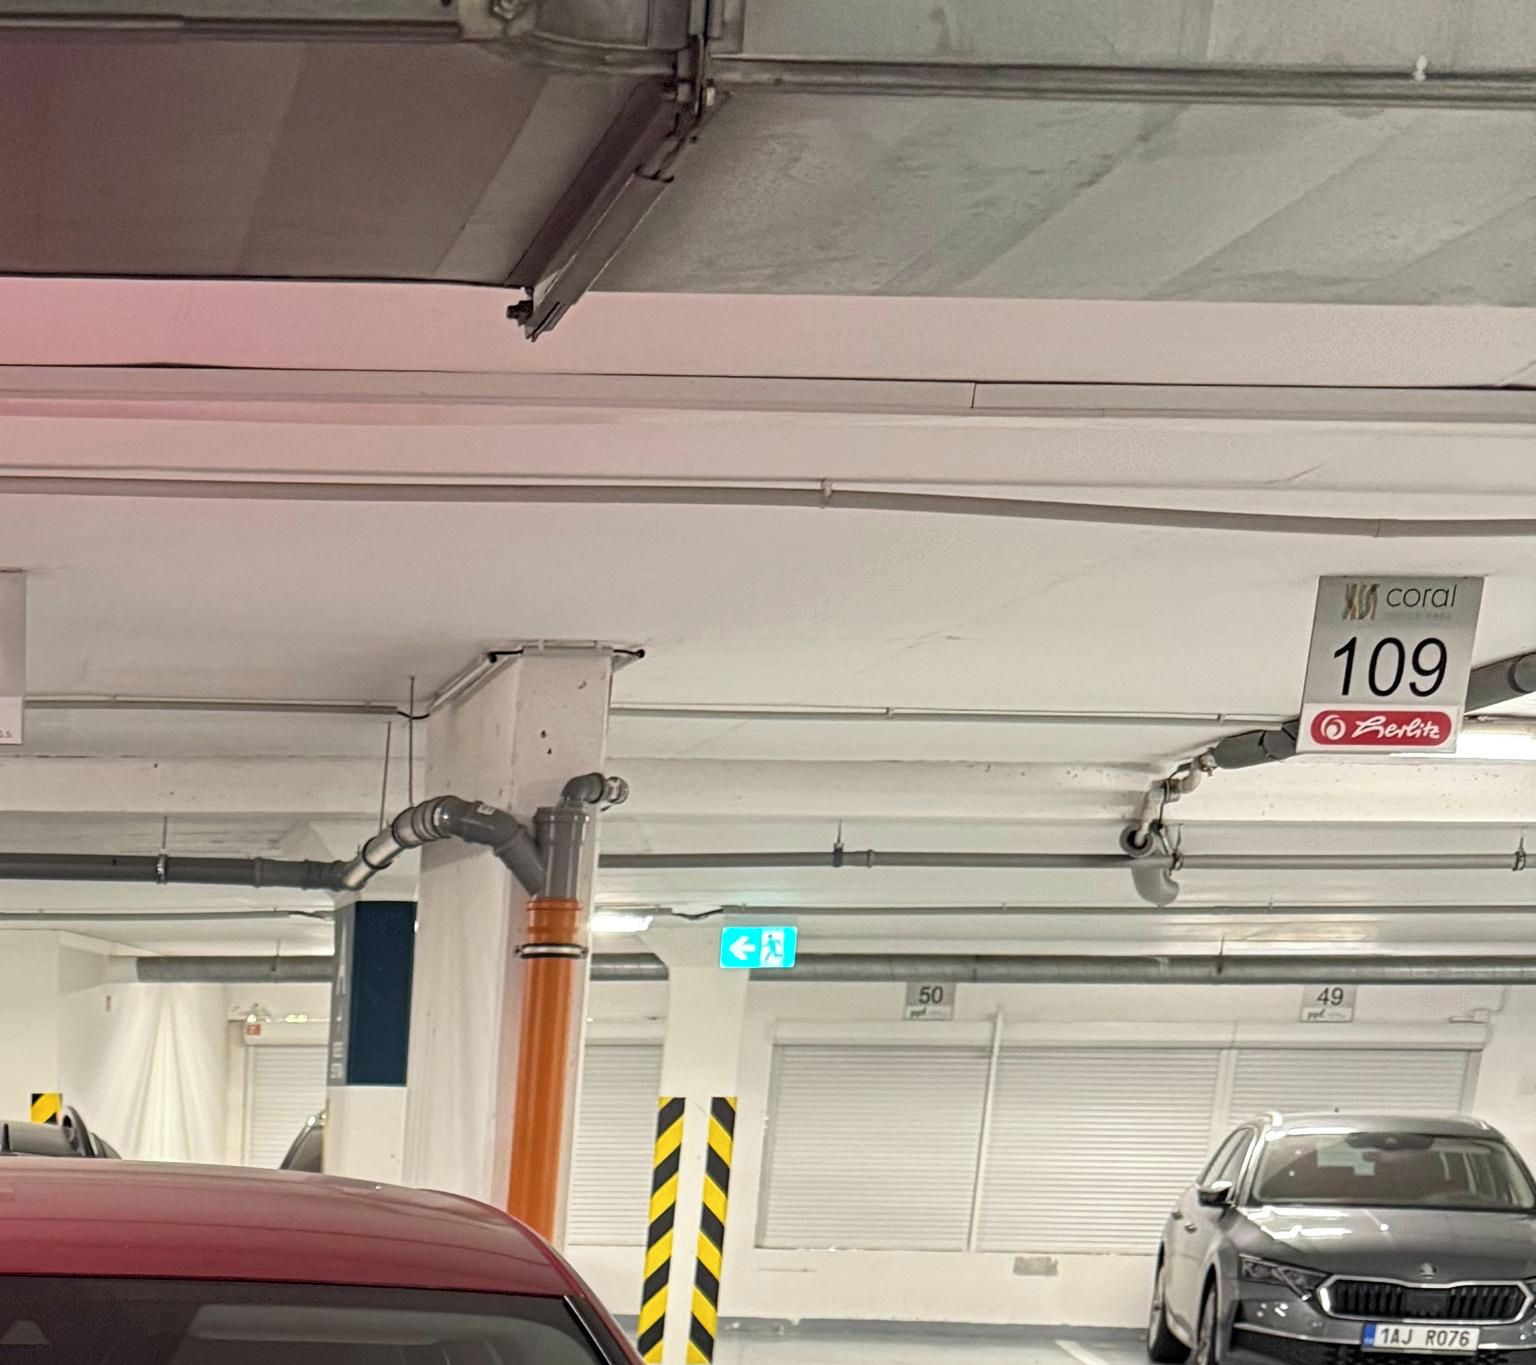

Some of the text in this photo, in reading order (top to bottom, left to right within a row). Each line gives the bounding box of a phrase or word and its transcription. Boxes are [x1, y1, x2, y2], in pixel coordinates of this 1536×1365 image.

[1386, 584, 1458, 608] coral
[1334, 636, 1448, 698] 109
[918, 985, 944, 1005] 50
[1316, 987, 1344, 1006] 49
[1380, 1327, 1413, 1345] 1AJ
[1425, 1330, 1471, 1347] R076
